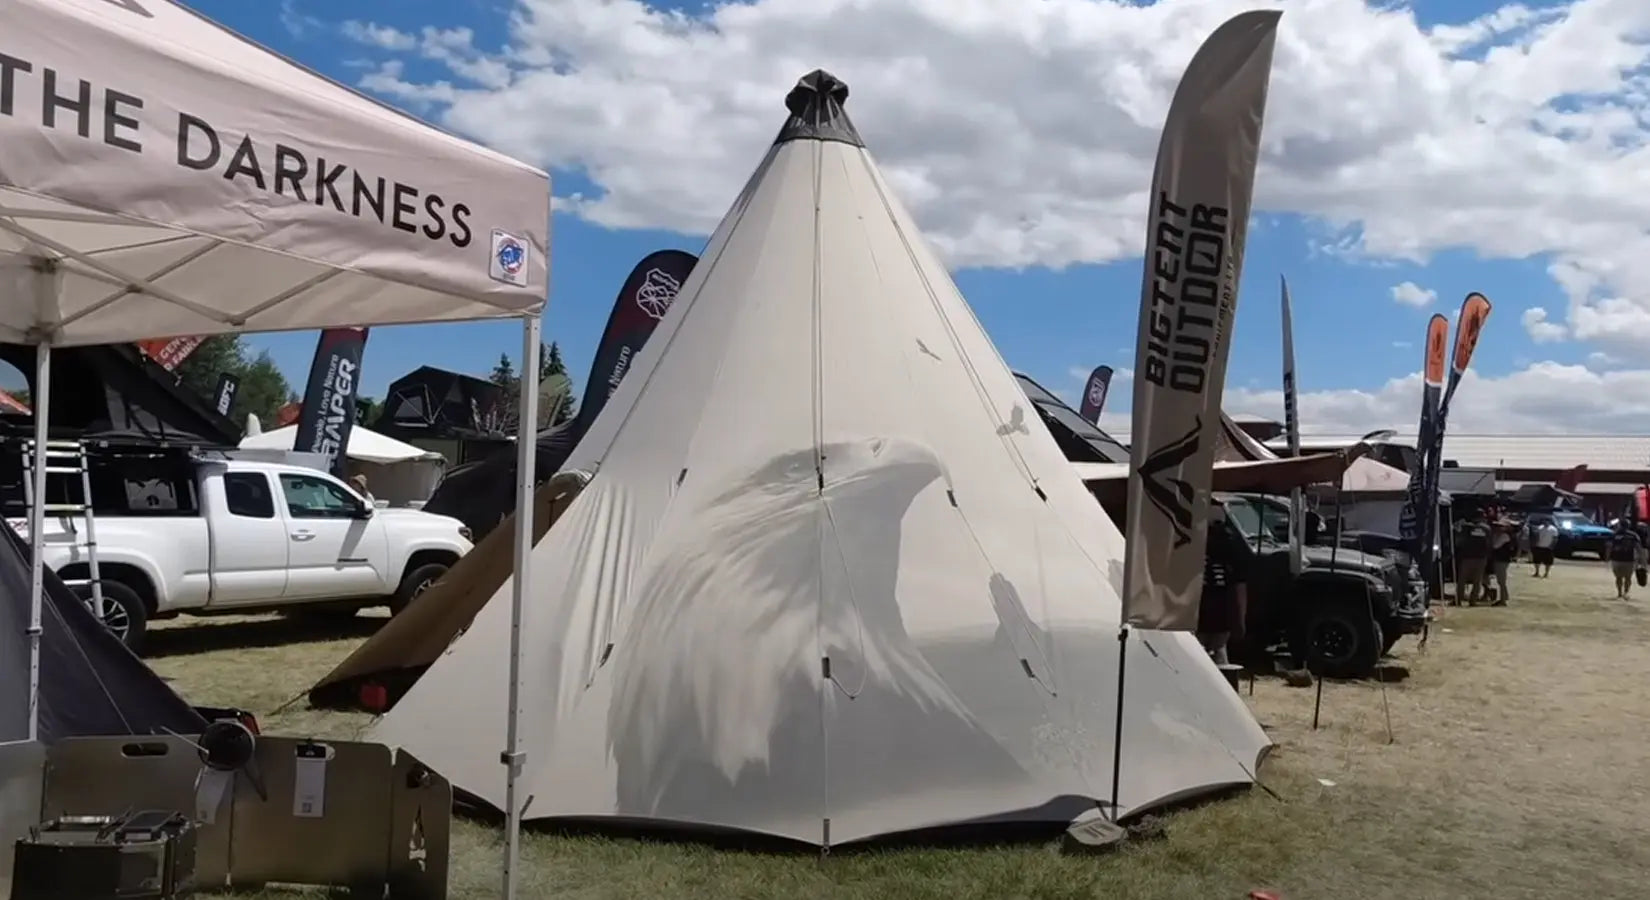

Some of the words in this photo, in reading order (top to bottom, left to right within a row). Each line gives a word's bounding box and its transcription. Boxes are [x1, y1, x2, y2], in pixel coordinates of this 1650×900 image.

[0, 53, 144, 153] THE
[177, 112, 472, 248] DARKNESS
[1145, 191, 1187, 388] BIGTENT
[321, 358, 356, 467] AMPER
[323, 354, 340, 389] Nature
